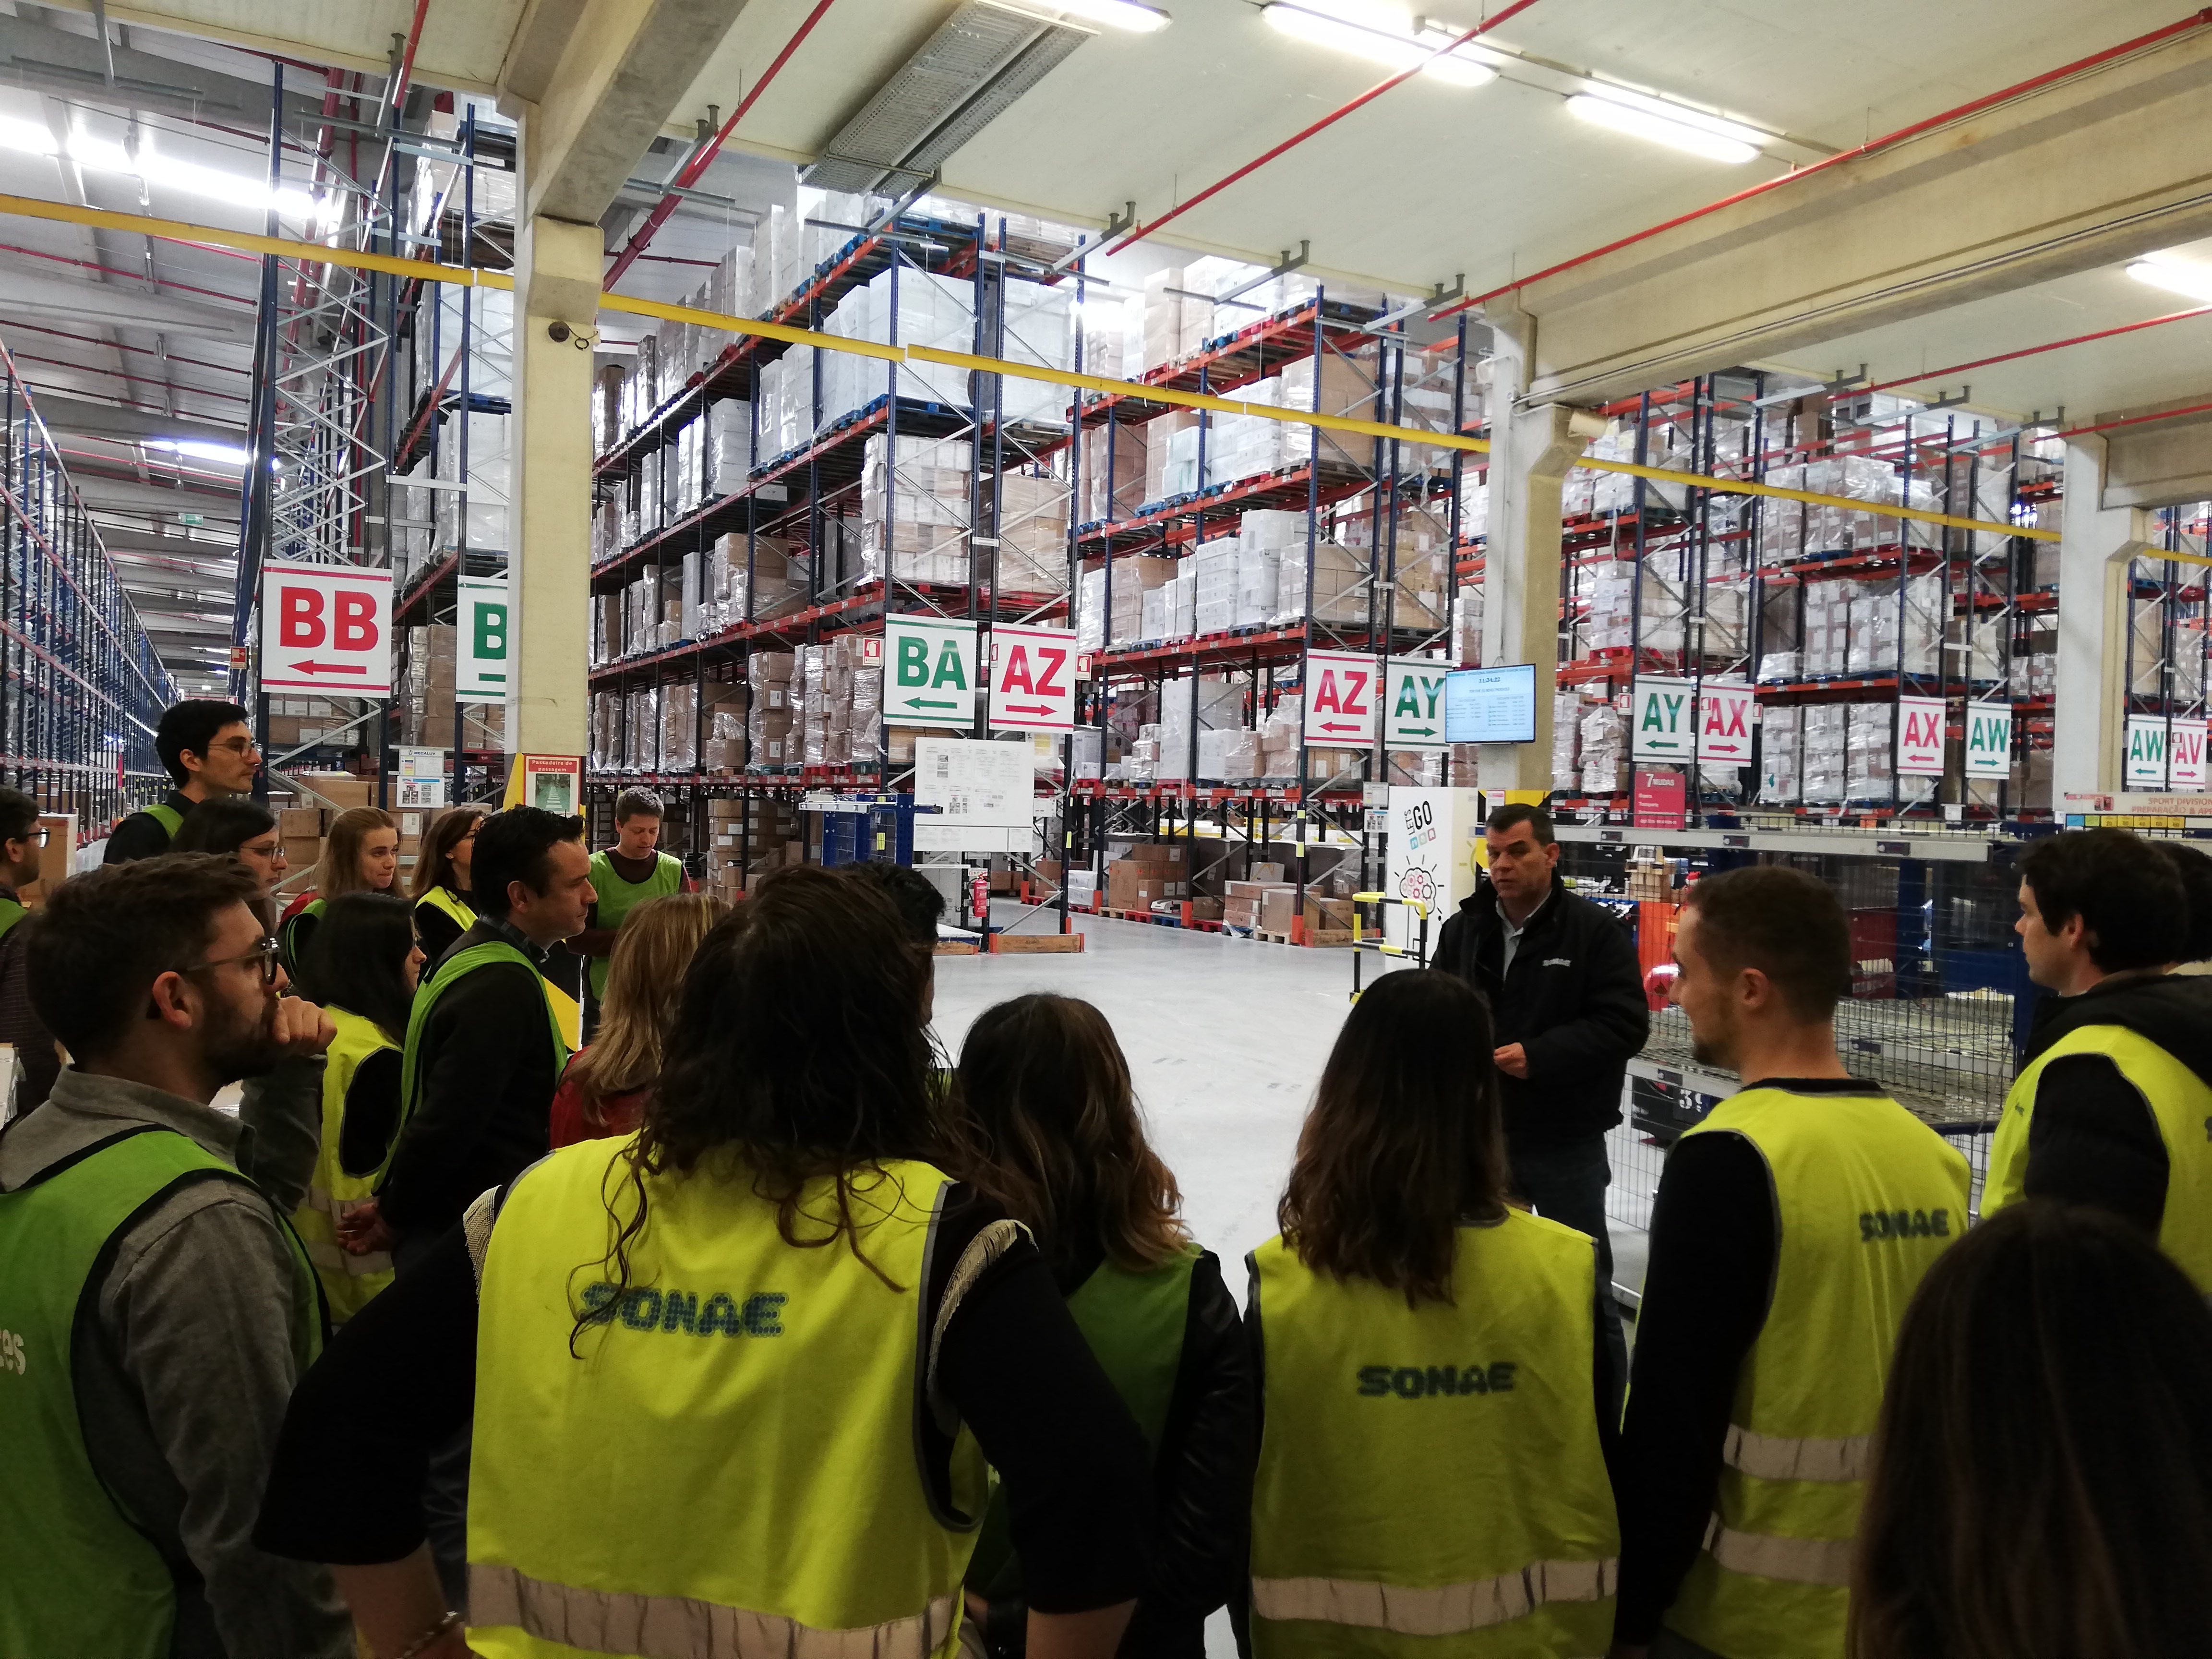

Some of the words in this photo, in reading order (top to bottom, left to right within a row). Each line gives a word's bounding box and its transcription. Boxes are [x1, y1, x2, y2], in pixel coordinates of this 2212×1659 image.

[280, 587, 379, 651] BB
[897, 636, 967, 690] BA
[1000, 645, 1066, 697] AZ
[1313, 669, 1368, 715] AZ
[1395, 676, 1445, 719] AY
[1642, 693, 1684, 732] AY
[1705, 697, 1747, 738] AX
[1904, 712, 1940, 748] AX
[1970, 717, 2009, 752] AW
[2130, 730, 2164, 761] AW
[2175, 732, 2203, 765] AV
[1646, 773, 1654, 787] 7
[1413, 801, 1432, 830] GO
[1859, 1208, 1950, 1241] SONAE
[578, 1281, 789, 1338] SONAE
[1357, 1361, 1517, 1399] SONAE
